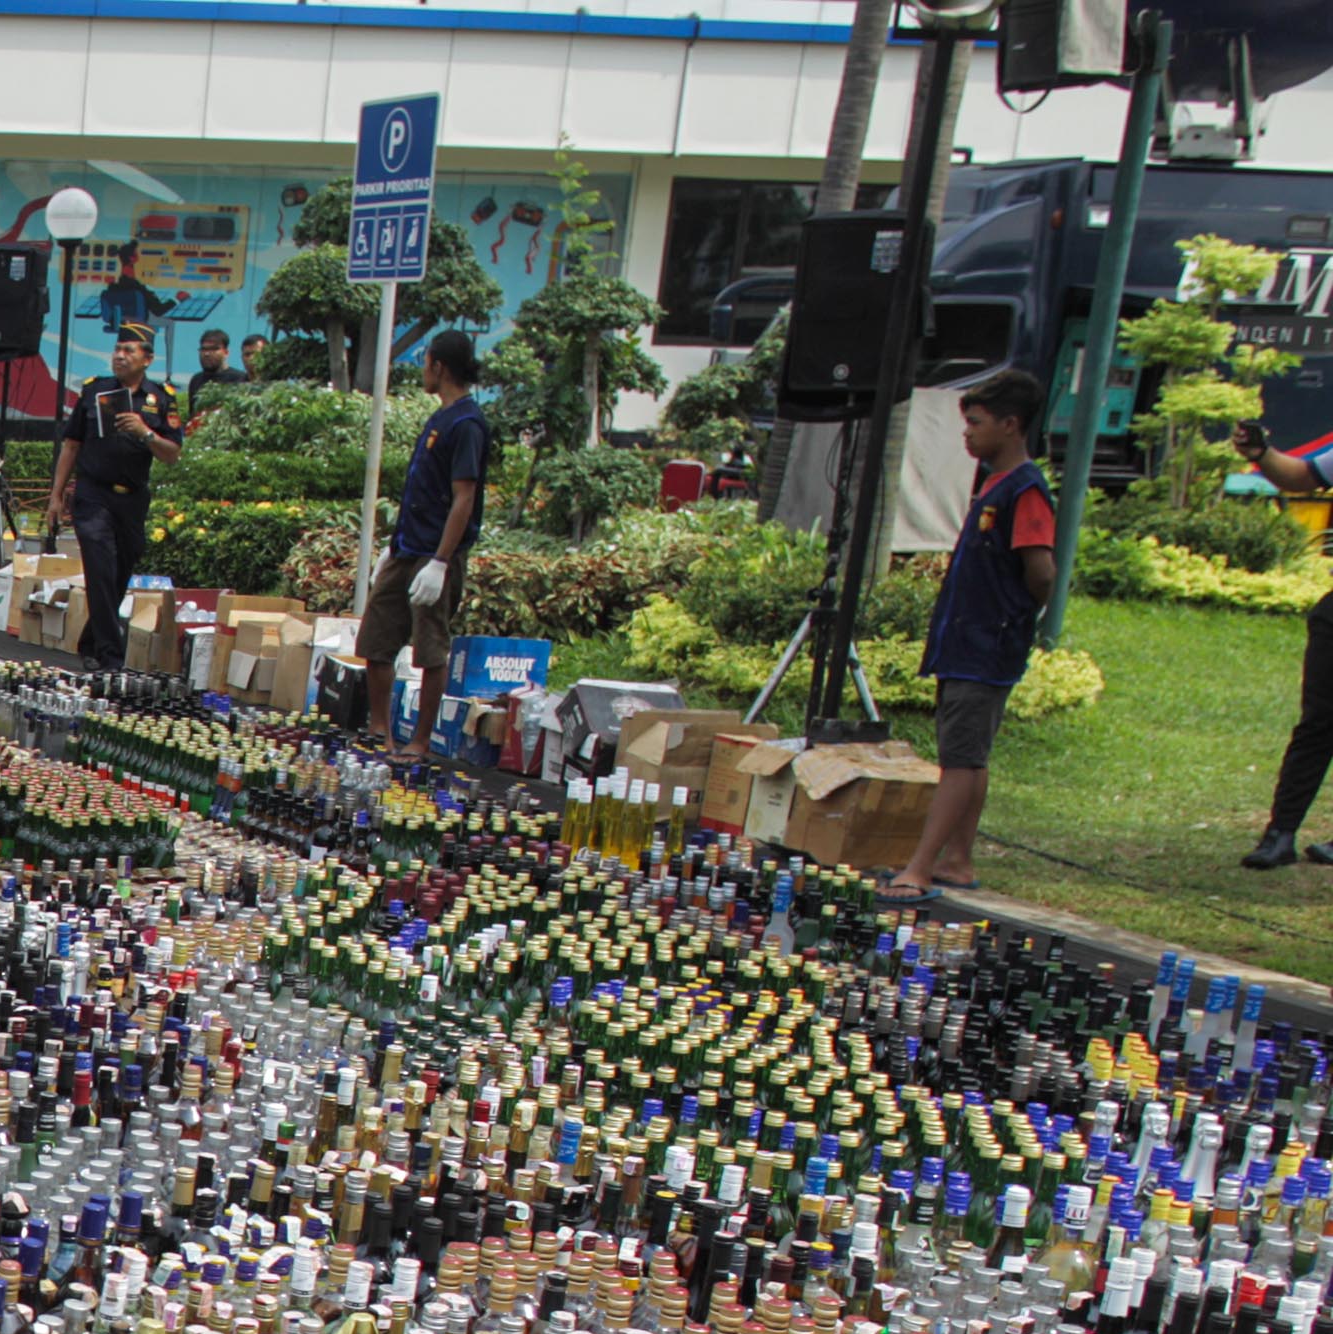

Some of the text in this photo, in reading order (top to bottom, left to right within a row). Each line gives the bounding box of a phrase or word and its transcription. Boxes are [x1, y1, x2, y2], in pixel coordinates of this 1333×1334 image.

[354, 176, 430, 196] PARKIR PRIORITAS
[484, 656, 536, 671] ABSOLUT
[489, 669, 529, 683] VODKA
